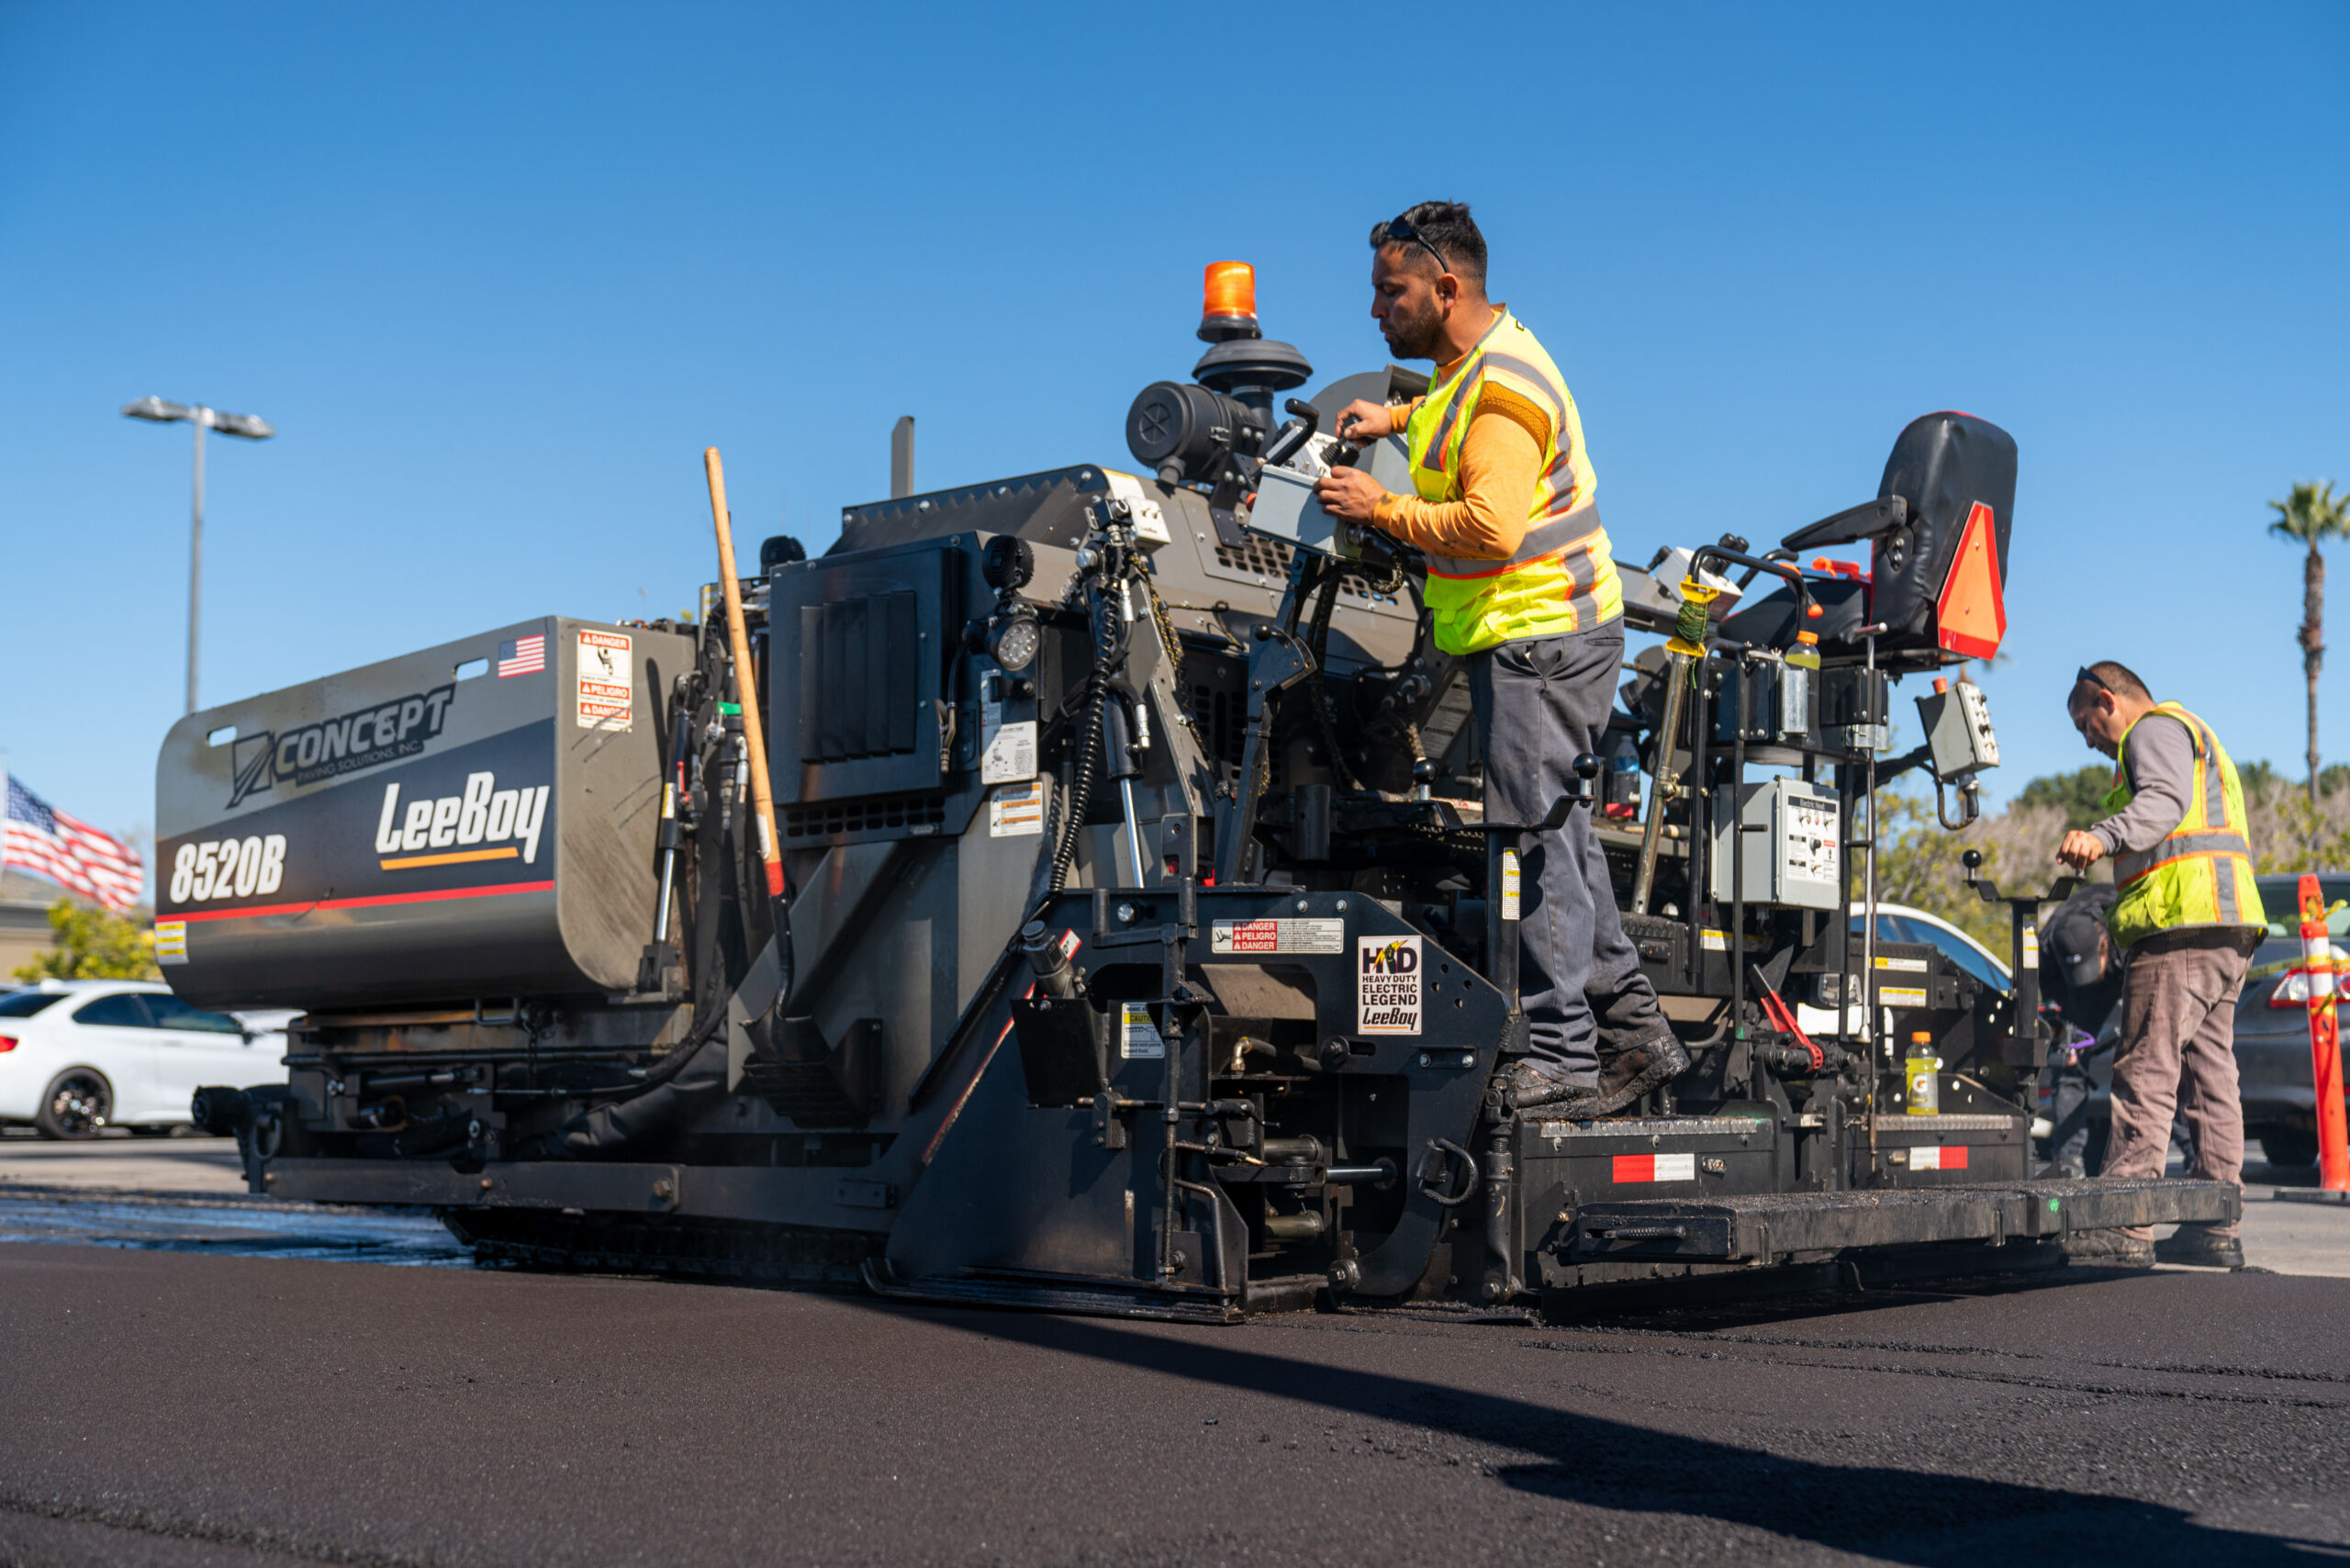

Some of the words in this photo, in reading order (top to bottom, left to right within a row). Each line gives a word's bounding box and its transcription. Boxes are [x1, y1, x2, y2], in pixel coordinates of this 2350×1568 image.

[591, 635, 627, 648] DANGER
[590, 684, 628, 698] PELIGRO
[591, 704, 627, 718] DANGER
[275, 689, 453, 776] CONCEPT
[297, 763, 337, 781] PAVING
[375, 772, 549, 864] LeeBoy
[170, 834, 286, 903] 8520B
[1241, 922, 1274, 931] DANGER
[1241, 932, 1276, 940] PELIGRO
[1241, 941, 1274, 949] DANGER
[1362, 975, 1392, 983] HEAVY
[1393, 975, 1417, 983] DUTY
[1362, 984, 1417, 993] ELECTRIC
[1362, 994, 1417, 1006] LEGEND
[1362, 1007, 1418, 1031] LeeBoy
